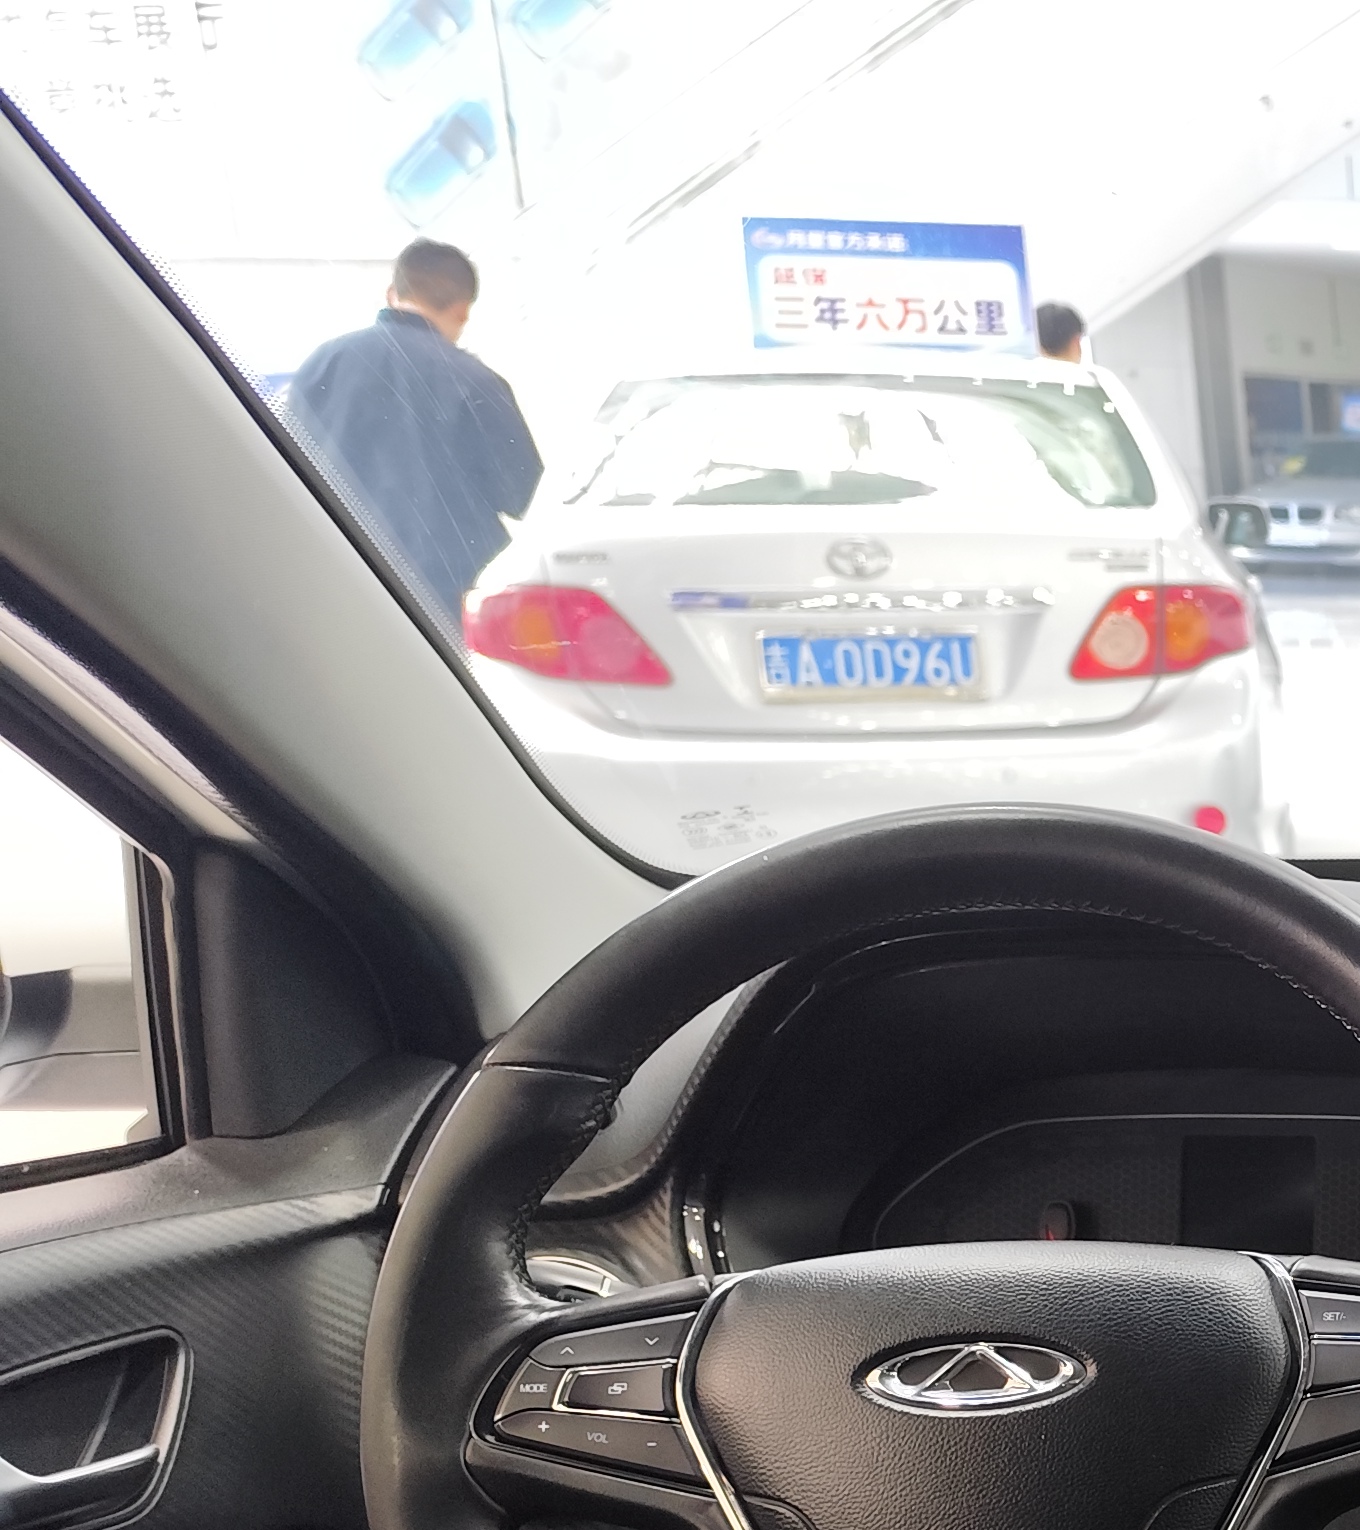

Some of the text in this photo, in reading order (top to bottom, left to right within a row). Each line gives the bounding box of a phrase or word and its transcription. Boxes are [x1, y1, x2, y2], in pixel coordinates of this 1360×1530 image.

[774, 295, 1009, 336] 三年六万公里
[519, 1383, 548, 1393] MODE
[586, 1431, 609, 1444] VOL
